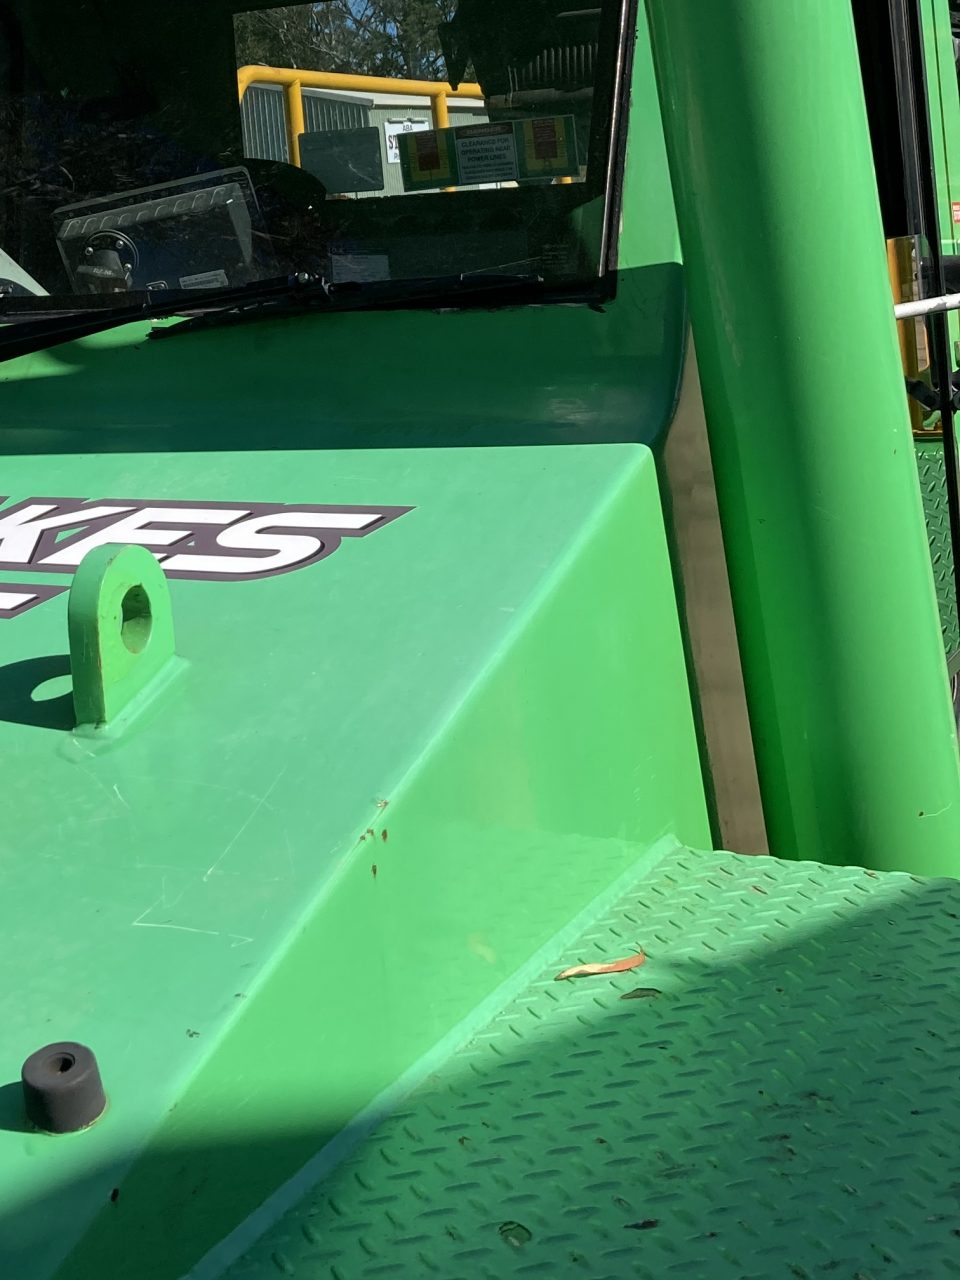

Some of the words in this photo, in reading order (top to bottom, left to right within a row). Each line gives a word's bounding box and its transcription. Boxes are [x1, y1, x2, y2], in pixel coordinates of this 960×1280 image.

[467, 127, 501, 135] DANGER
[461, 139, 496, 148] CLEARANCE
[460, 147, 495, 156] OPERATING
